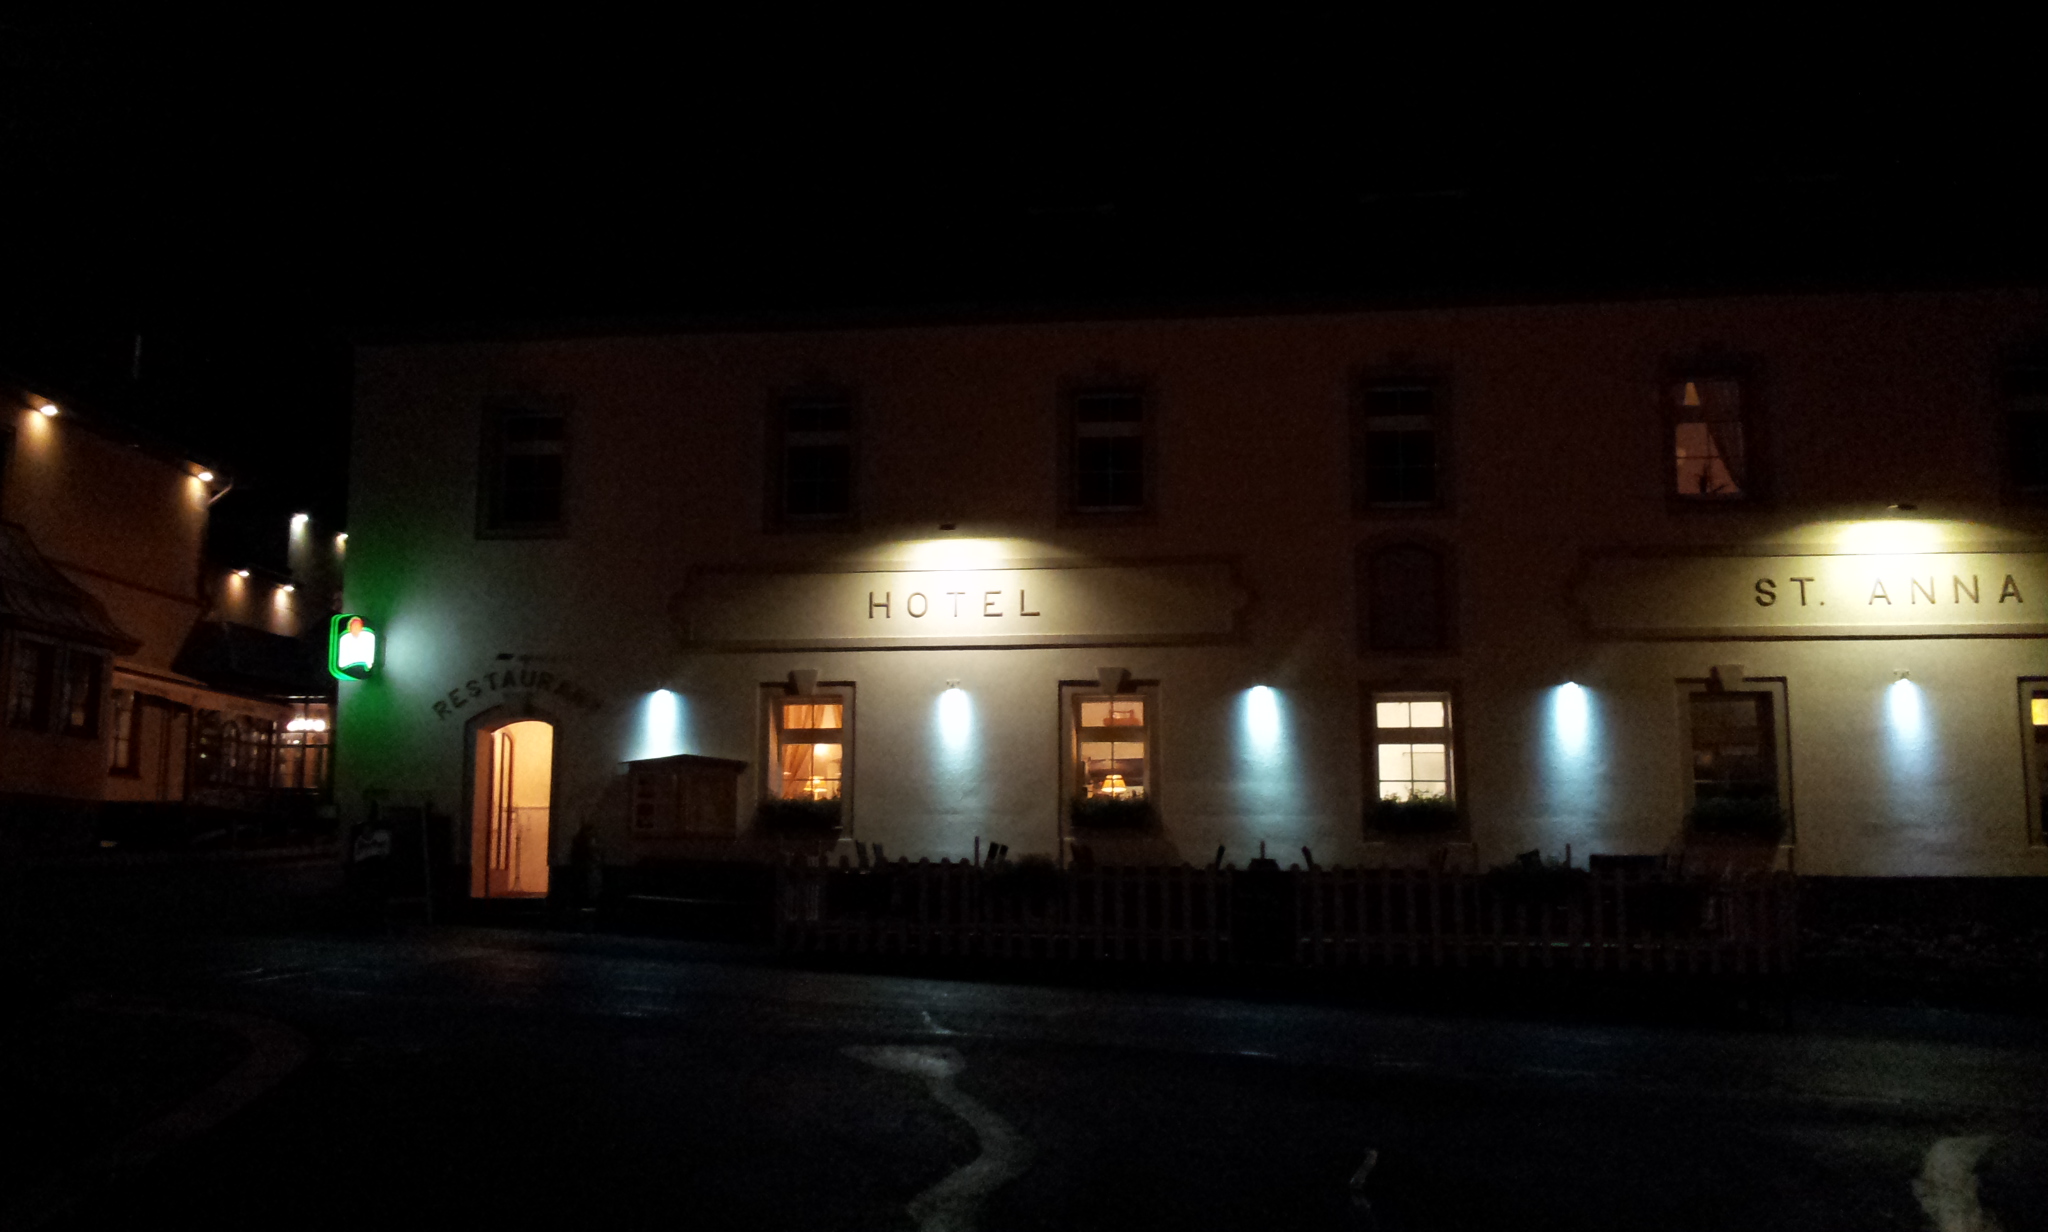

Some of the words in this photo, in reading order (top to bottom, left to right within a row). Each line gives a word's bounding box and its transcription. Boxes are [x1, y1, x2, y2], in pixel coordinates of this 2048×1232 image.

[868, 589, 1041, 619] HOTEL
[1755, 577, 1825, 607] ST.
[1868, 574, 2024, 606] ANNA
[432, 669, 603, 720] RESTAURAN
